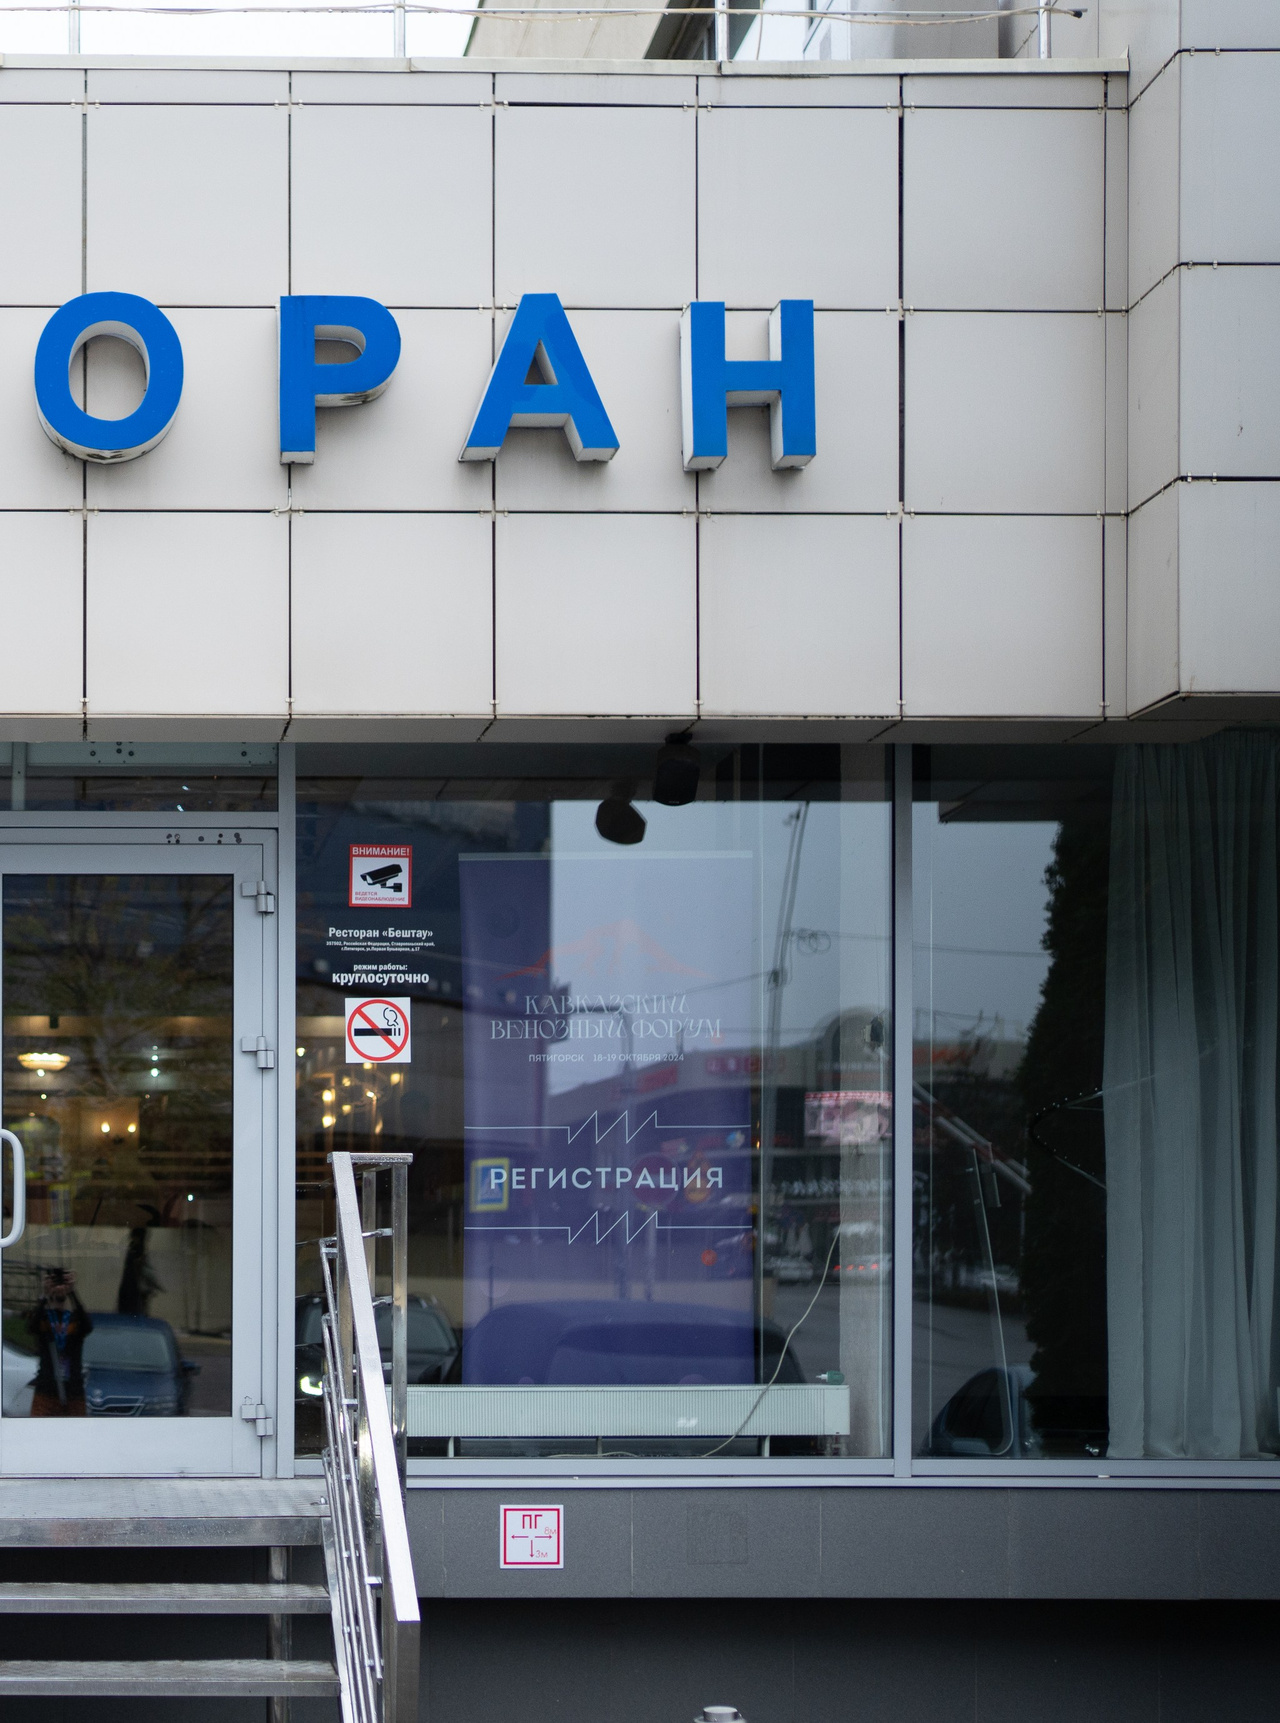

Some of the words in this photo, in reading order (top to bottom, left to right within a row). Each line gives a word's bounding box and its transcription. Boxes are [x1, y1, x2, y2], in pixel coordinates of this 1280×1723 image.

[352, 847, 410, 856] ВНИМАНИЕ!
[328, 927, 380, 940] Ресторан
[382, 927, 433, 940] «Бештау»
[353, 964, 378, 972] режим
[379, 963, 408, 971] работы:
[332, 973, 429, 986] круглосуточно
[525, 990, 690, 1014] КАВКАЗСКИЙ
[490, 1014, 628, 1040] ВЕНОЗНЫЙ
[631, 1017, 721, 1038] ФОРУМ
[528, 1053, 585, 1062] ПЯТИГОРСК
[618, 1053, 661, 1062] ОКТЯБРЯ
[663, 1053, 684, 1062] 2024
[490, 1167, 723, 1191] РЕГИСТРАЦИЯ
[522, 1514, 543, 1529] ПГ
